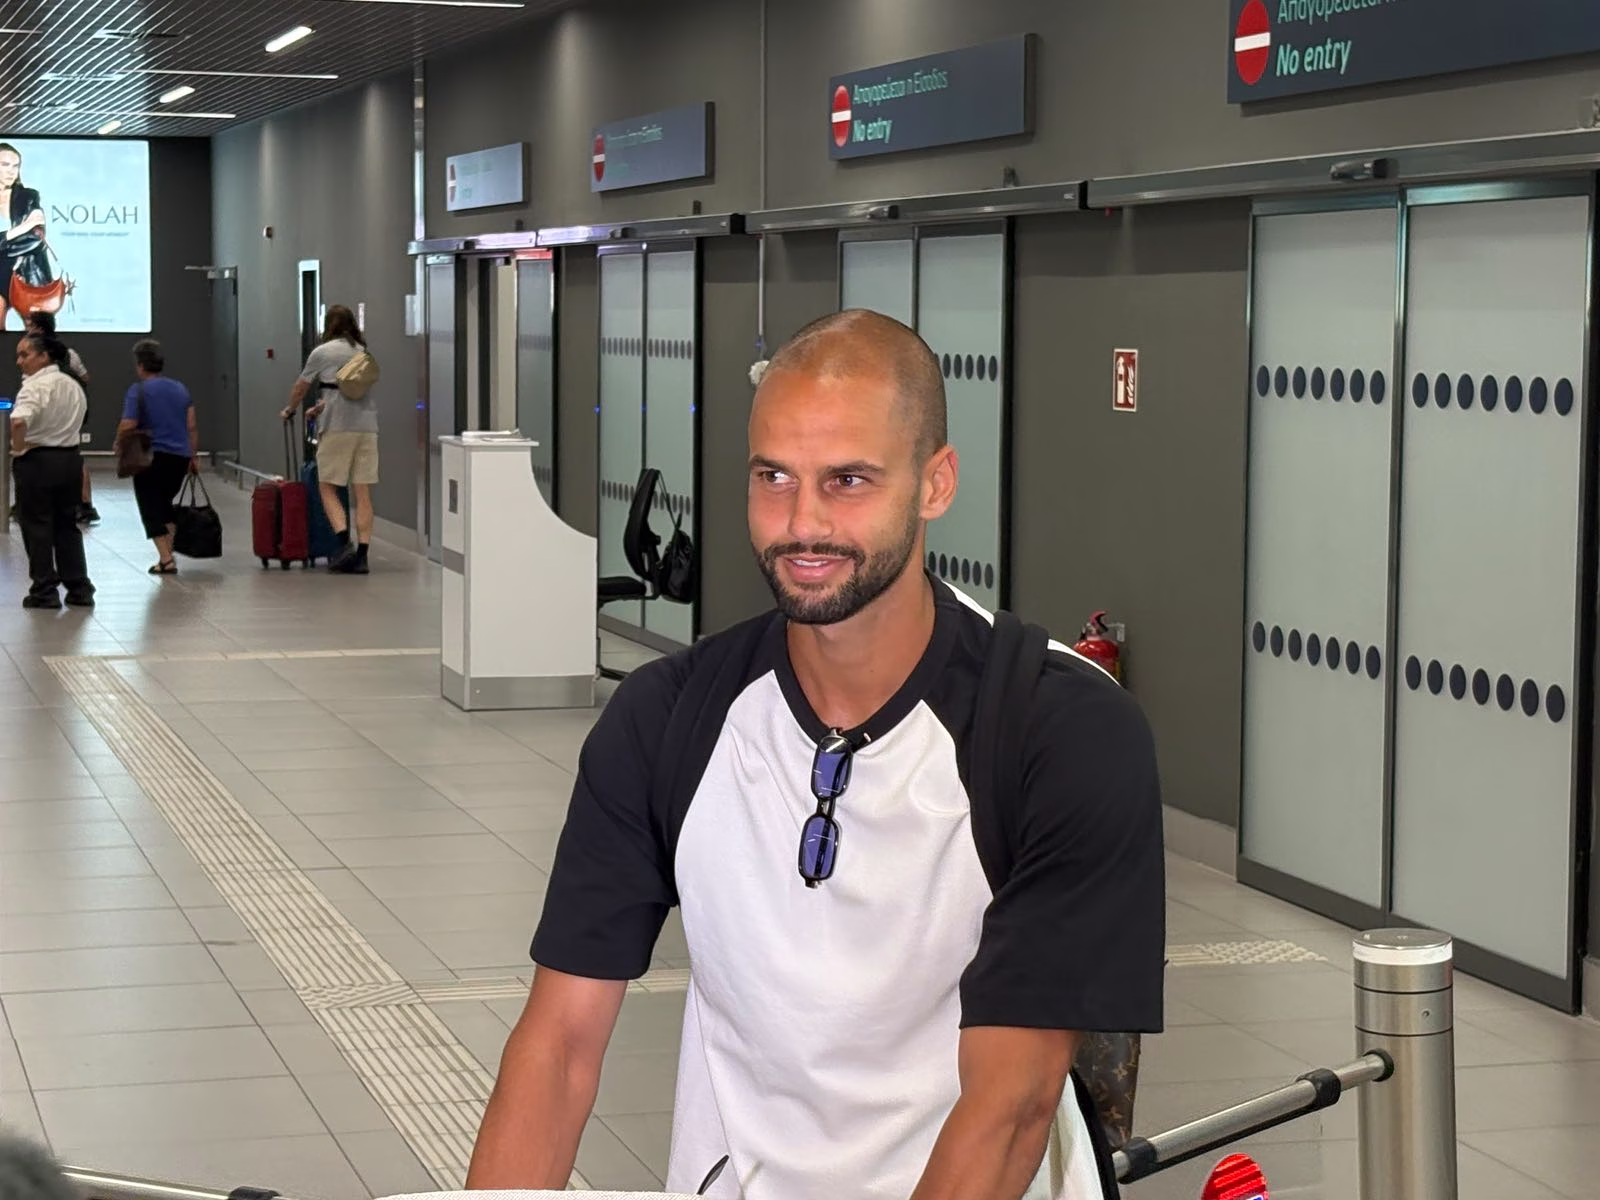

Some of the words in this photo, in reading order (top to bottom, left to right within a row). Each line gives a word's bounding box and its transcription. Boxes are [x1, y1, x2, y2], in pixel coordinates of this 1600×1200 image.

[1277, 0, 1382, 25] Απαγορε
[1276, 43, 1299, 77] No
[1304, 37, 1352, 75] entry
[852, 120, 865, 142] No
[867, 118, 892, 143] entry
[52, 204, 138, 224] NOLAH
